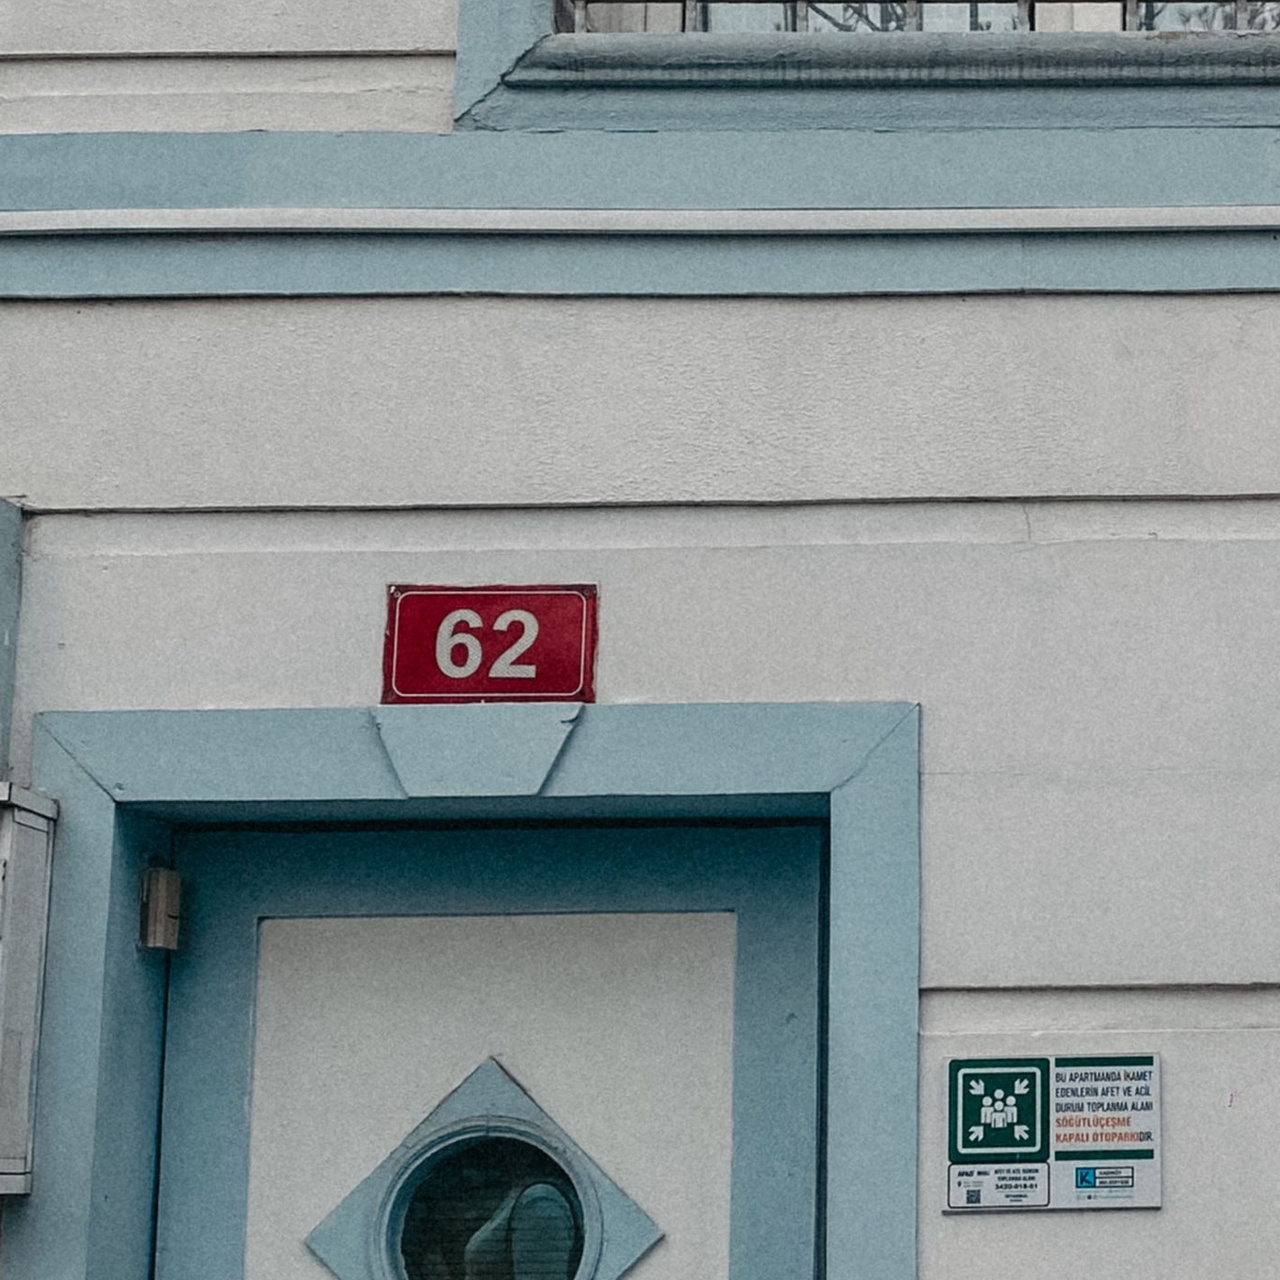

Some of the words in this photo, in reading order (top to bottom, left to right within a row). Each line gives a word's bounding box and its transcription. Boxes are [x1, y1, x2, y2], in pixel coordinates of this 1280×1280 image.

[435, 608, 540, 679] 62
[1055, 1072, 1067, 1083] BU
[1069, 1071, 1121, 1082] APARTMANDA
[1123, 1069, 1153, 1081] İKAMET
[1055, 1085, 1099, 1098] EDENLERİN
[1101, 1086, 1120, 1097] AFET
[1122, 1086, 1132, 1097] VE
[1134, 1084, 1152, 1096] ACİL
[1055, 1102, 1084, 1113] DURUM
[1087, 1101, 1128, 1113] TOPLANMA
[1130, 1101, 1153, 1111] ALANI
[1055, 1132, 1089, 1143] KAPALI
[1080, 1171, 1092, 1185] K
